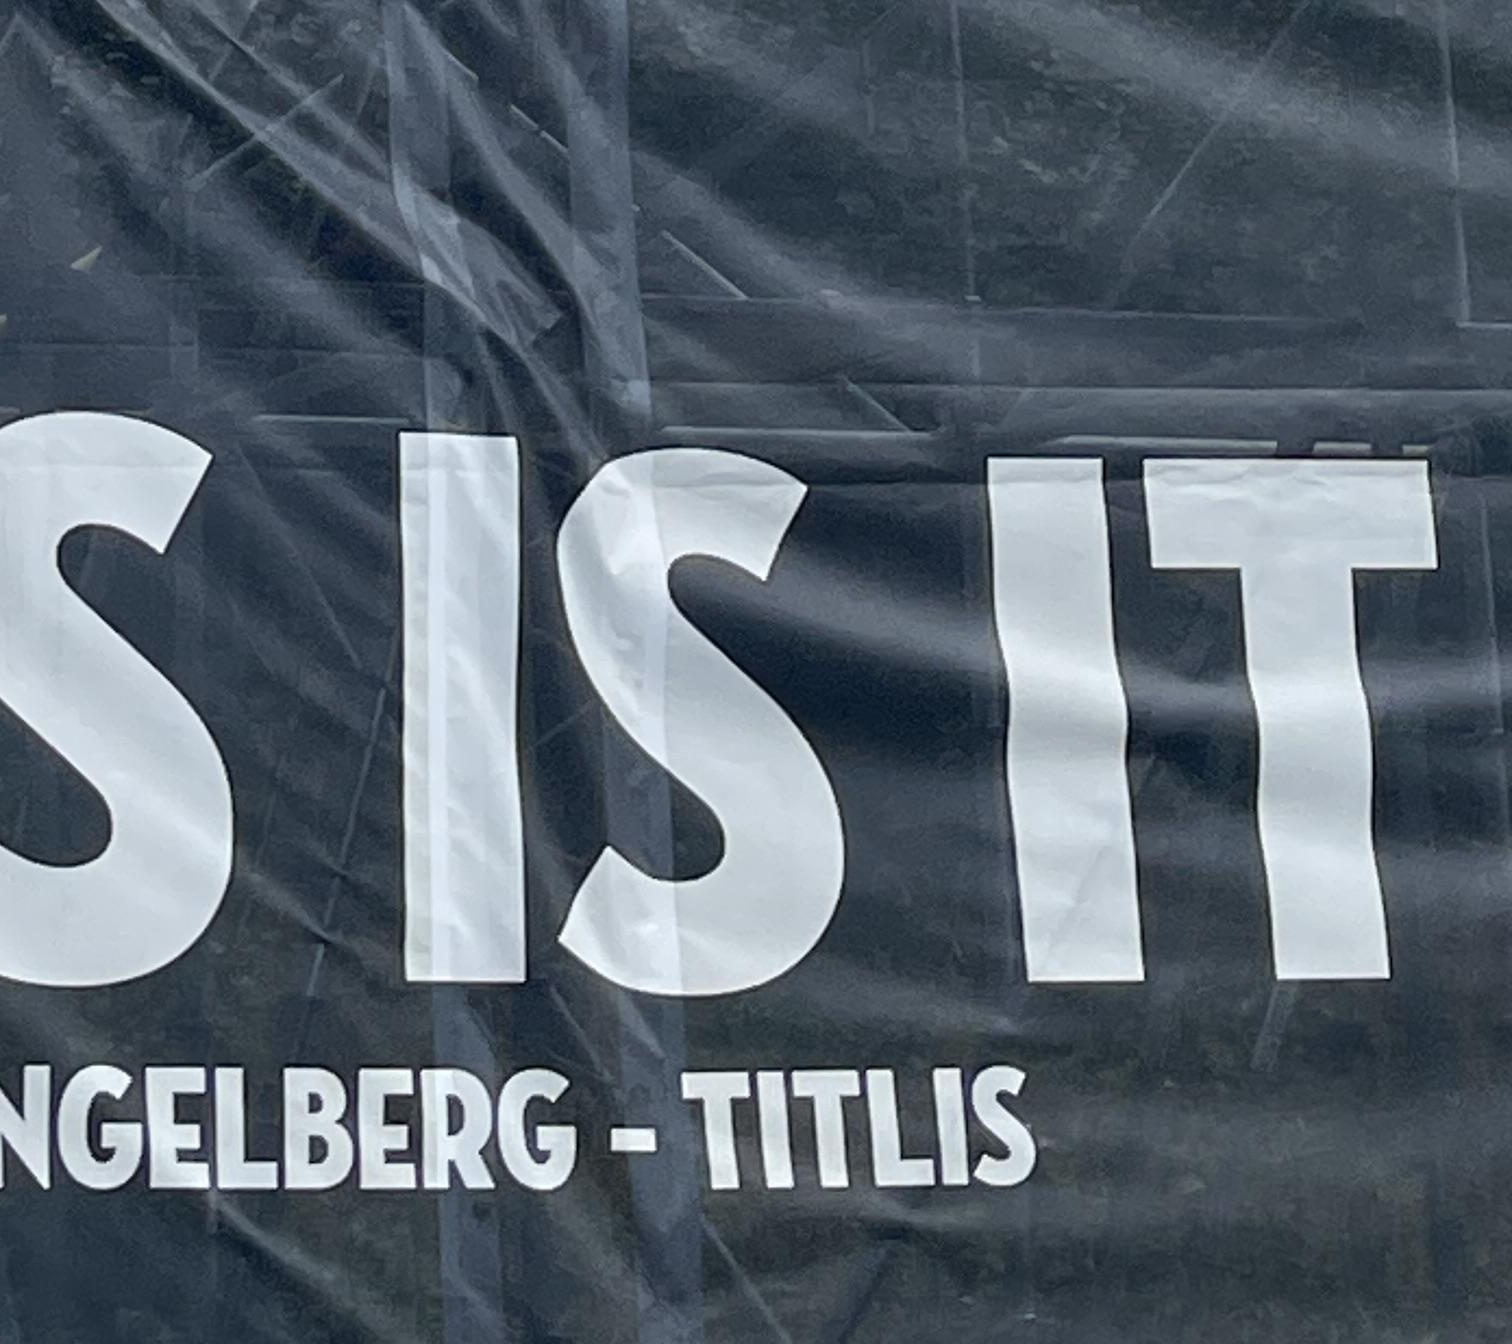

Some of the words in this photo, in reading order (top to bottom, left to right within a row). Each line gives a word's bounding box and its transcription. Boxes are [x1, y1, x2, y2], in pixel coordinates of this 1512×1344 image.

[398, 432, 845, 997] IS
[986, 457, 1439, 984] IT
[679, 1066, 1037, 1190] TITLIS
